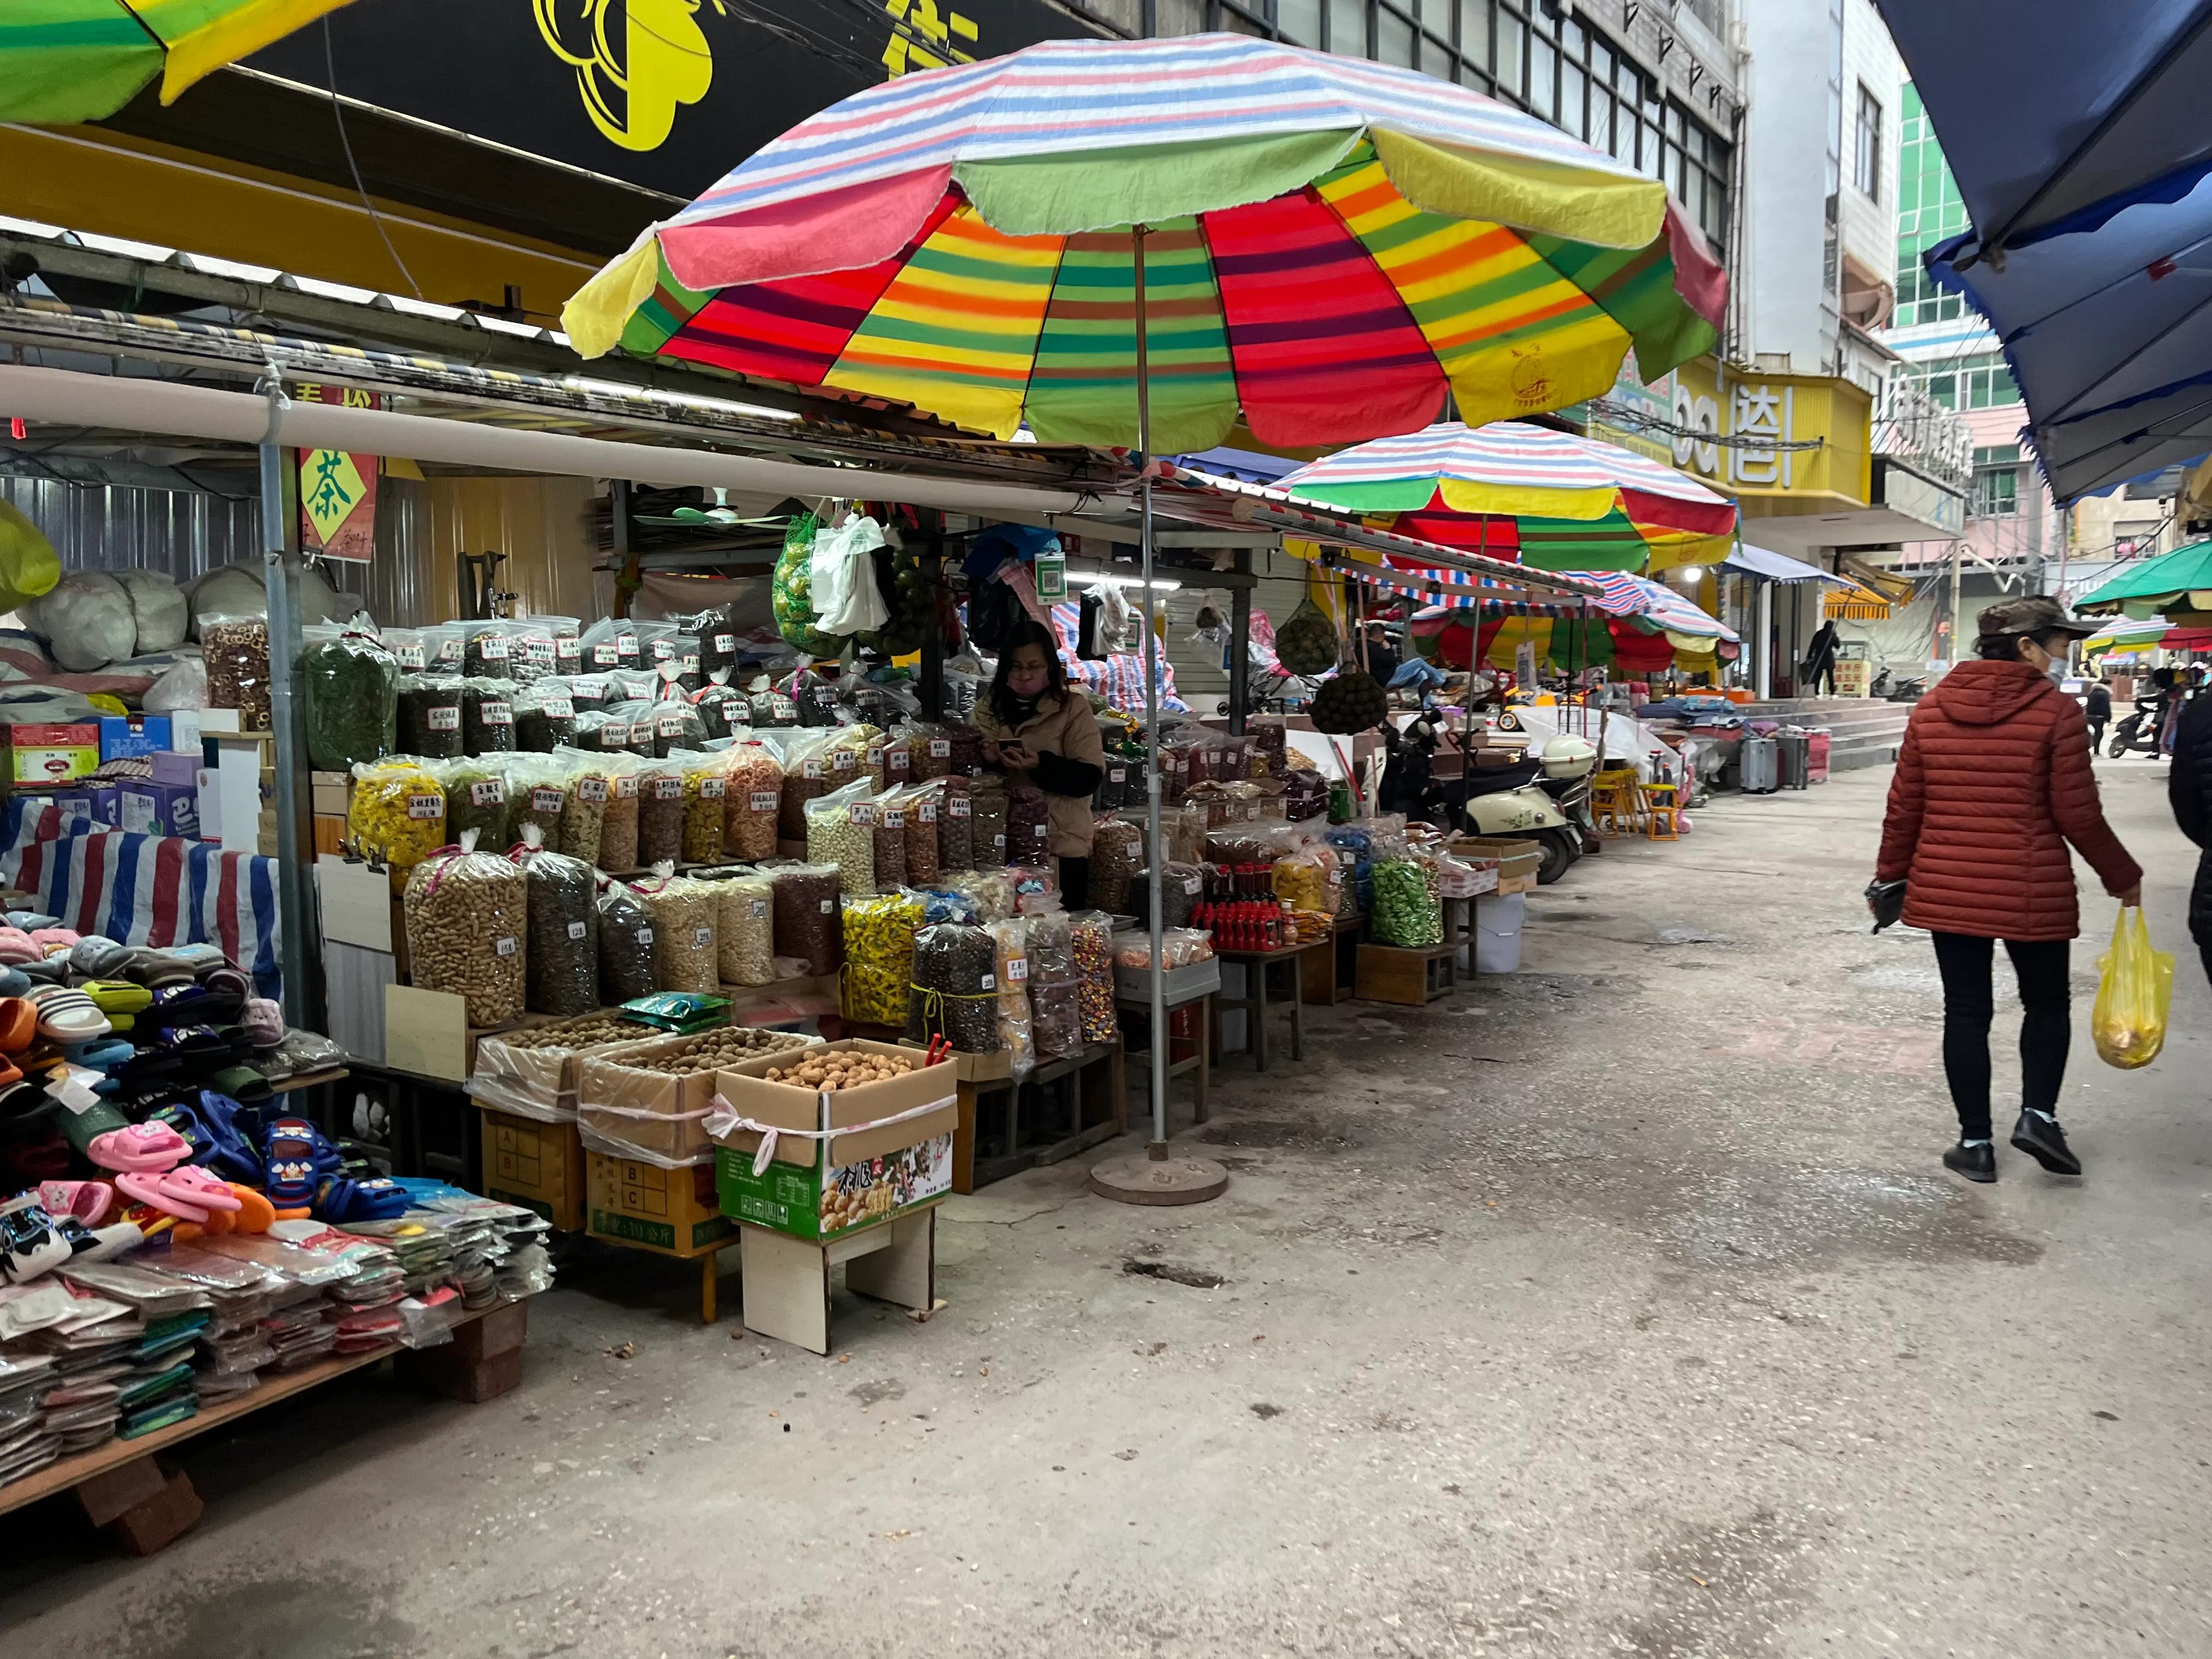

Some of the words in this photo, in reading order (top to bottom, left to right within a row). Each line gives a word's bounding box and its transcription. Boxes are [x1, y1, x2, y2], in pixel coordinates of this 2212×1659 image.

[307, 450, 351, 521] 茶
[504, 1131, 510, 1142] A
[504, 1158, 511, 1169] B
[629, 1167, 636, 1180] B
[629, 1192, 636, 1204] C
